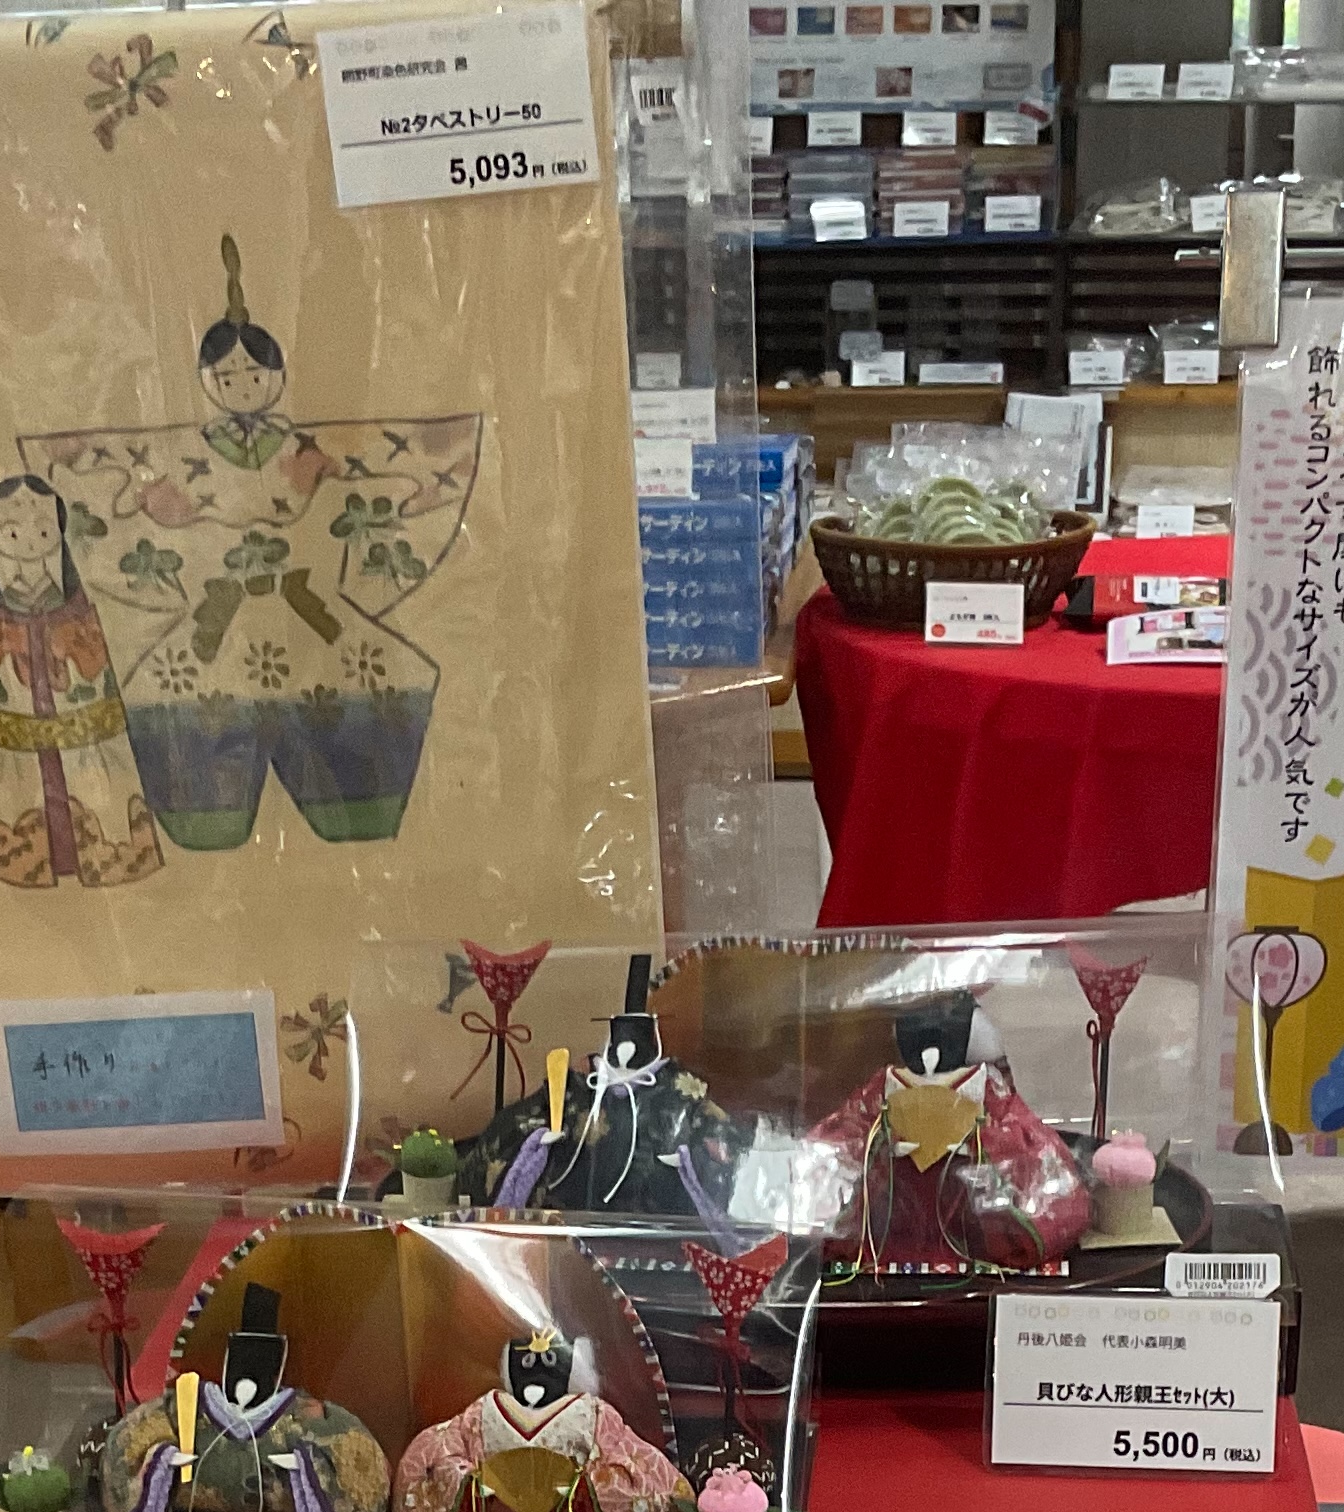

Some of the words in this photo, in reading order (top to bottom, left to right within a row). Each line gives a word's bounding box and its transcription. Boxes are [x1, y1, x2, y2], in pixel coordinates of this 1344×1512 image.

[449, 151, 529, 188] 5,093
[1280, 346, 1341, 843] 飾れるコンパクトなサイズが人気です
[1113, 1430, 1199, 1461] 5,500
